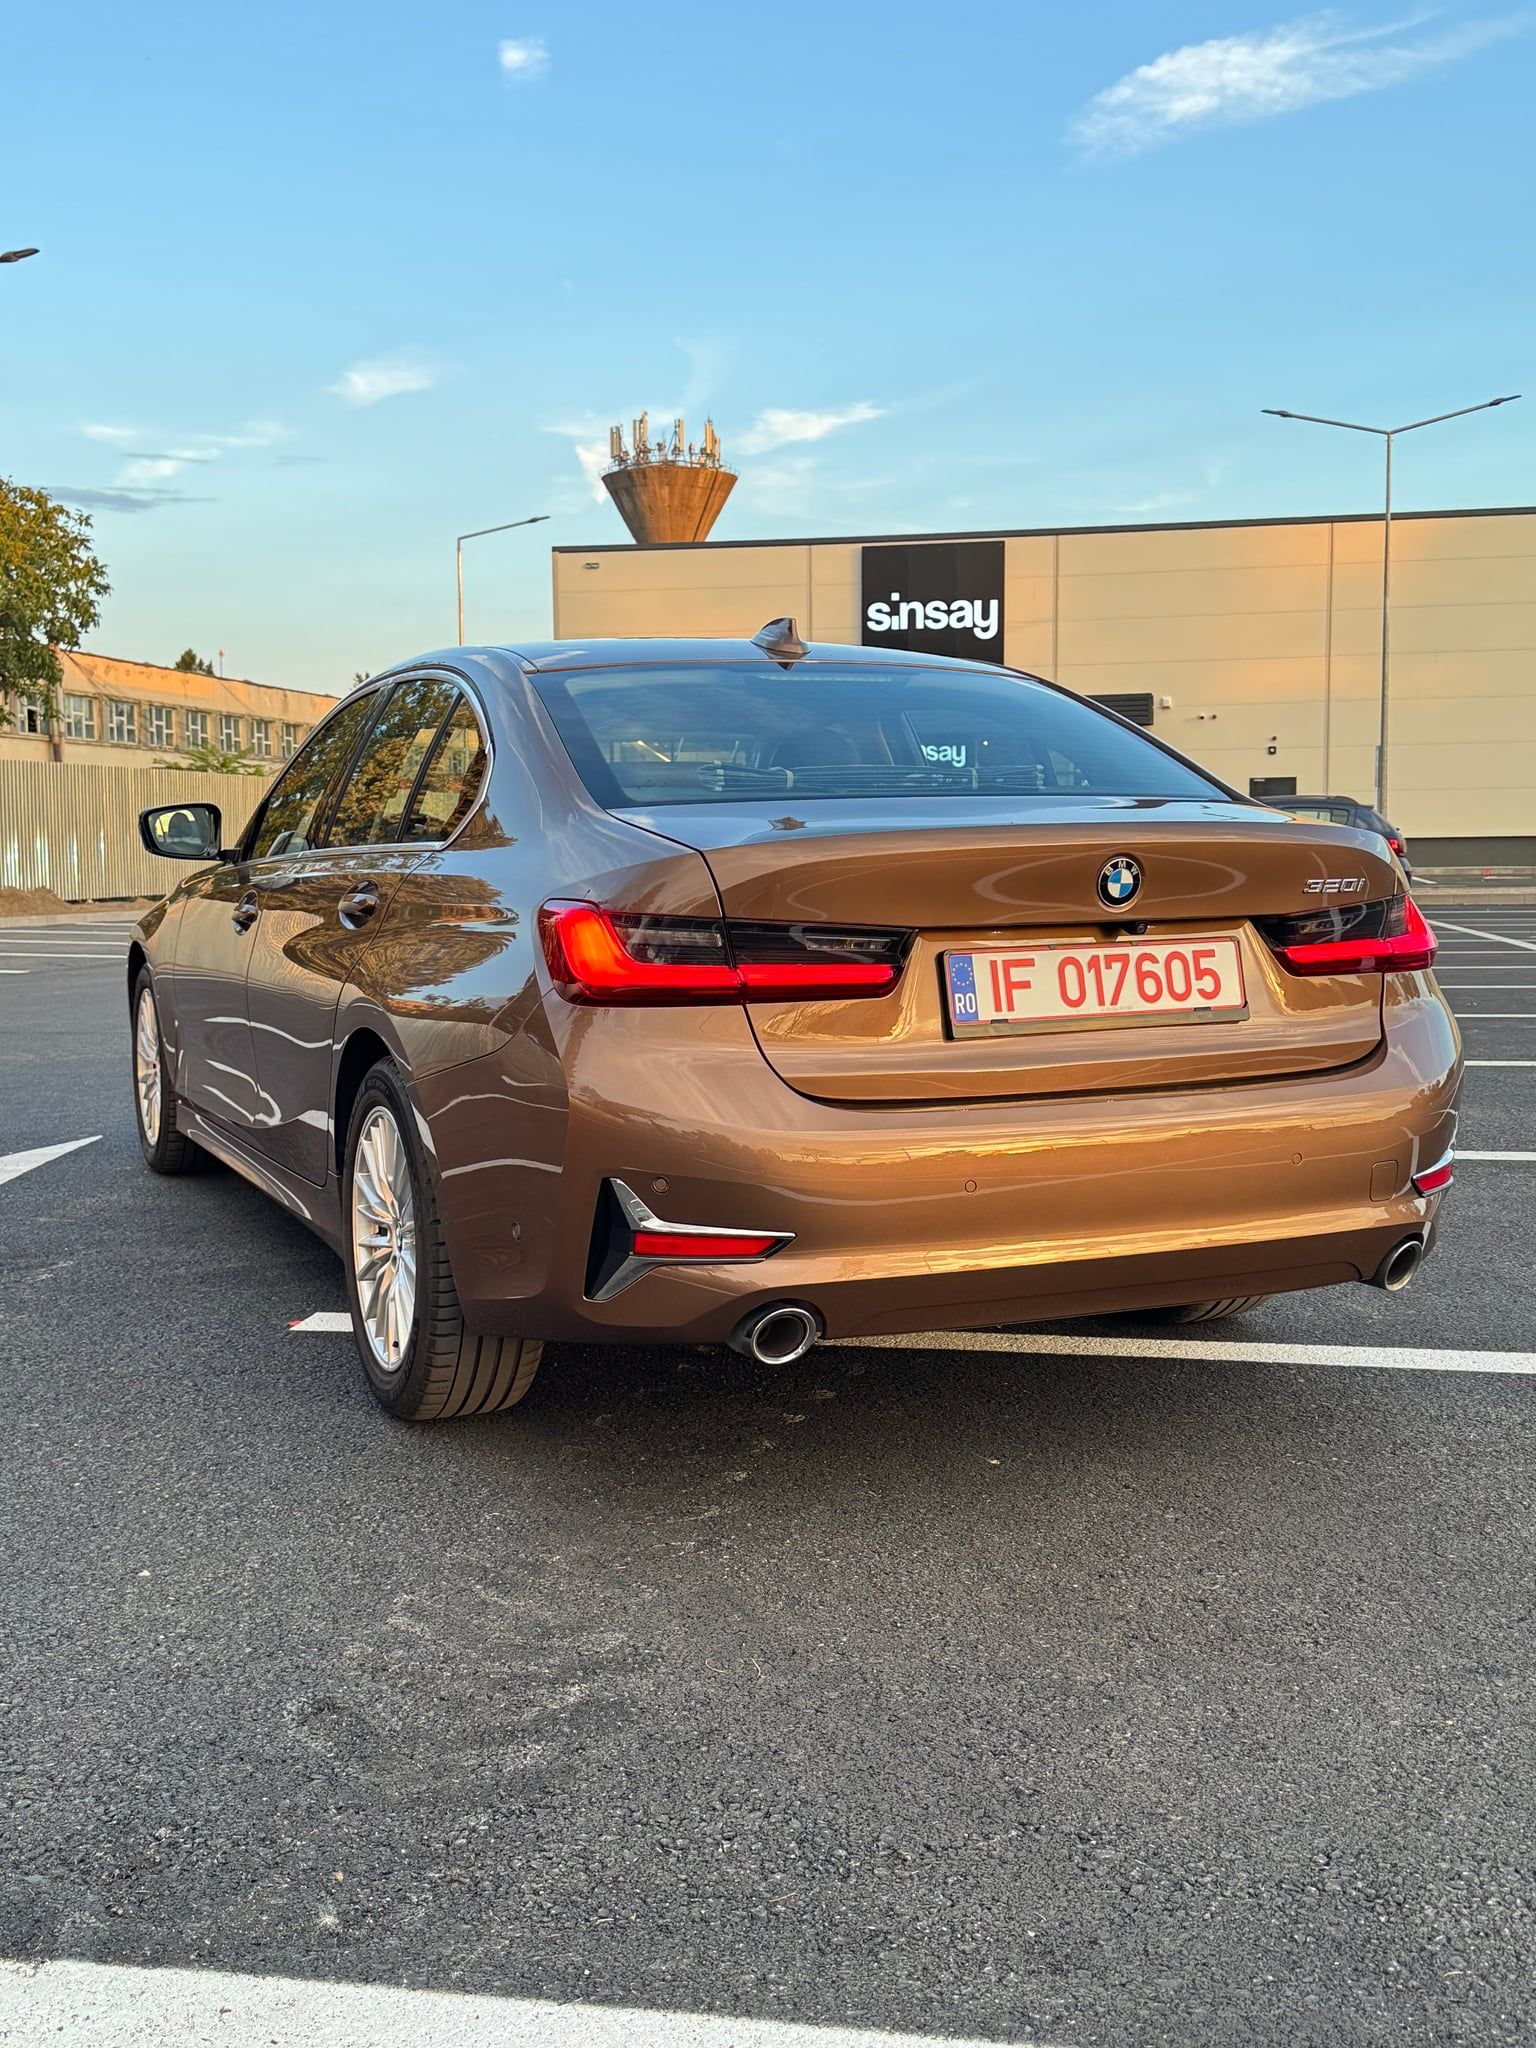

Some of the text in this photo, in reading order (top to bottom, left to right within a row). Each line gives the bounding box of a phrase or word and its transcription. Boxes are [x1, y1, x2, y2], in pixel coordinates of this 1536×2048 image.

[867, 592, 999, 640] sinsay
[1104, 860, 1139, 876] BMW
[1303, 878, 1366, 893] 320i
[990, 949, 1221, 1012] IF 017605
[954, 993, 976, 1014] RO
